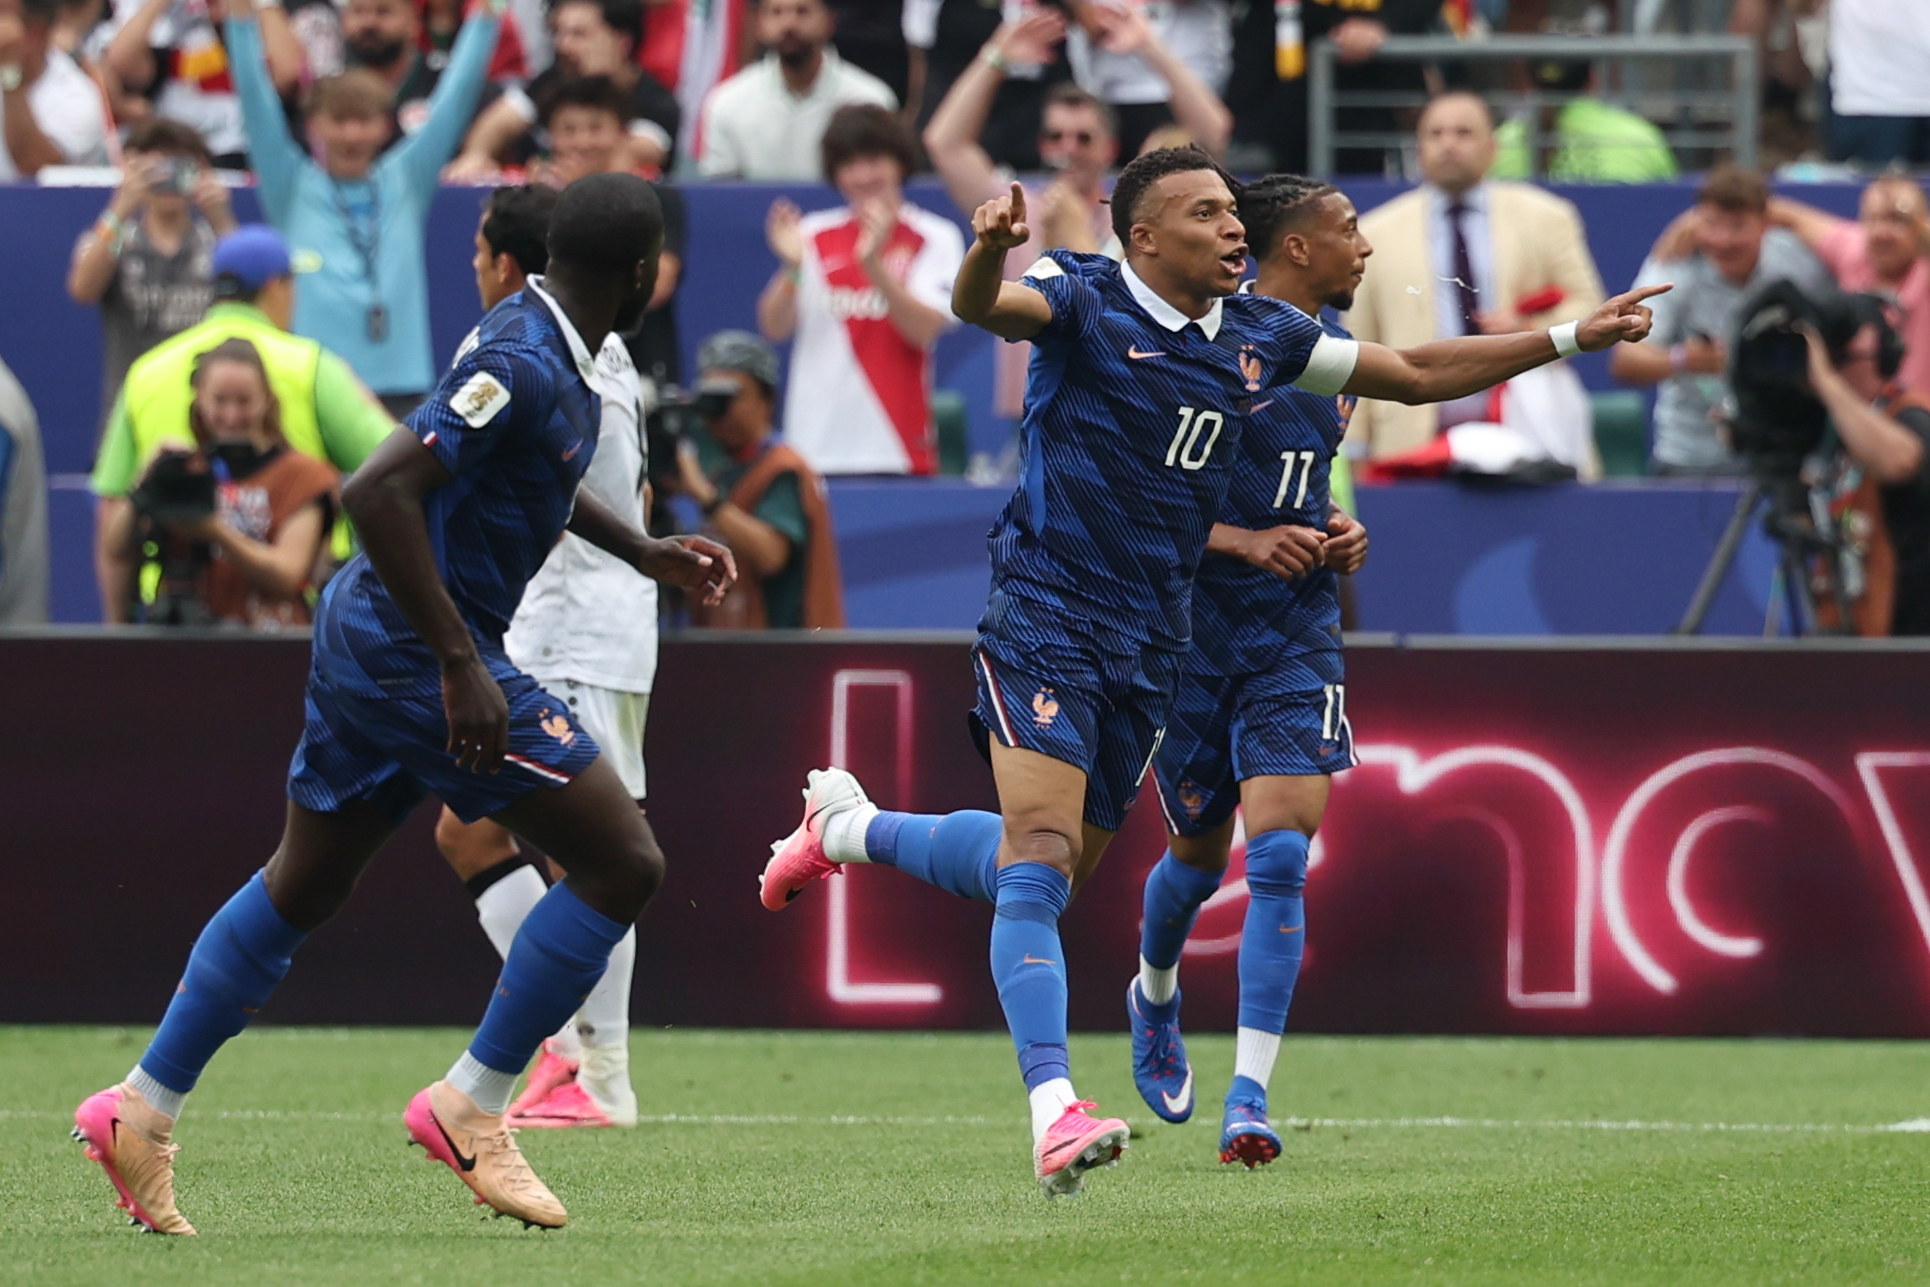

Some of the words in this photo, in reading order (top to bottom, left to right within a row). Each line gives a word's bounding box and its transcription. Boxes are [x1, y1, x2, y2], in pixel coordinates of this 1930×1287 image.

[1164, 406, 1224, 471] 10
[1272, 450, 1315, 509] 11
[1322, 683, 1345, 742] 11
